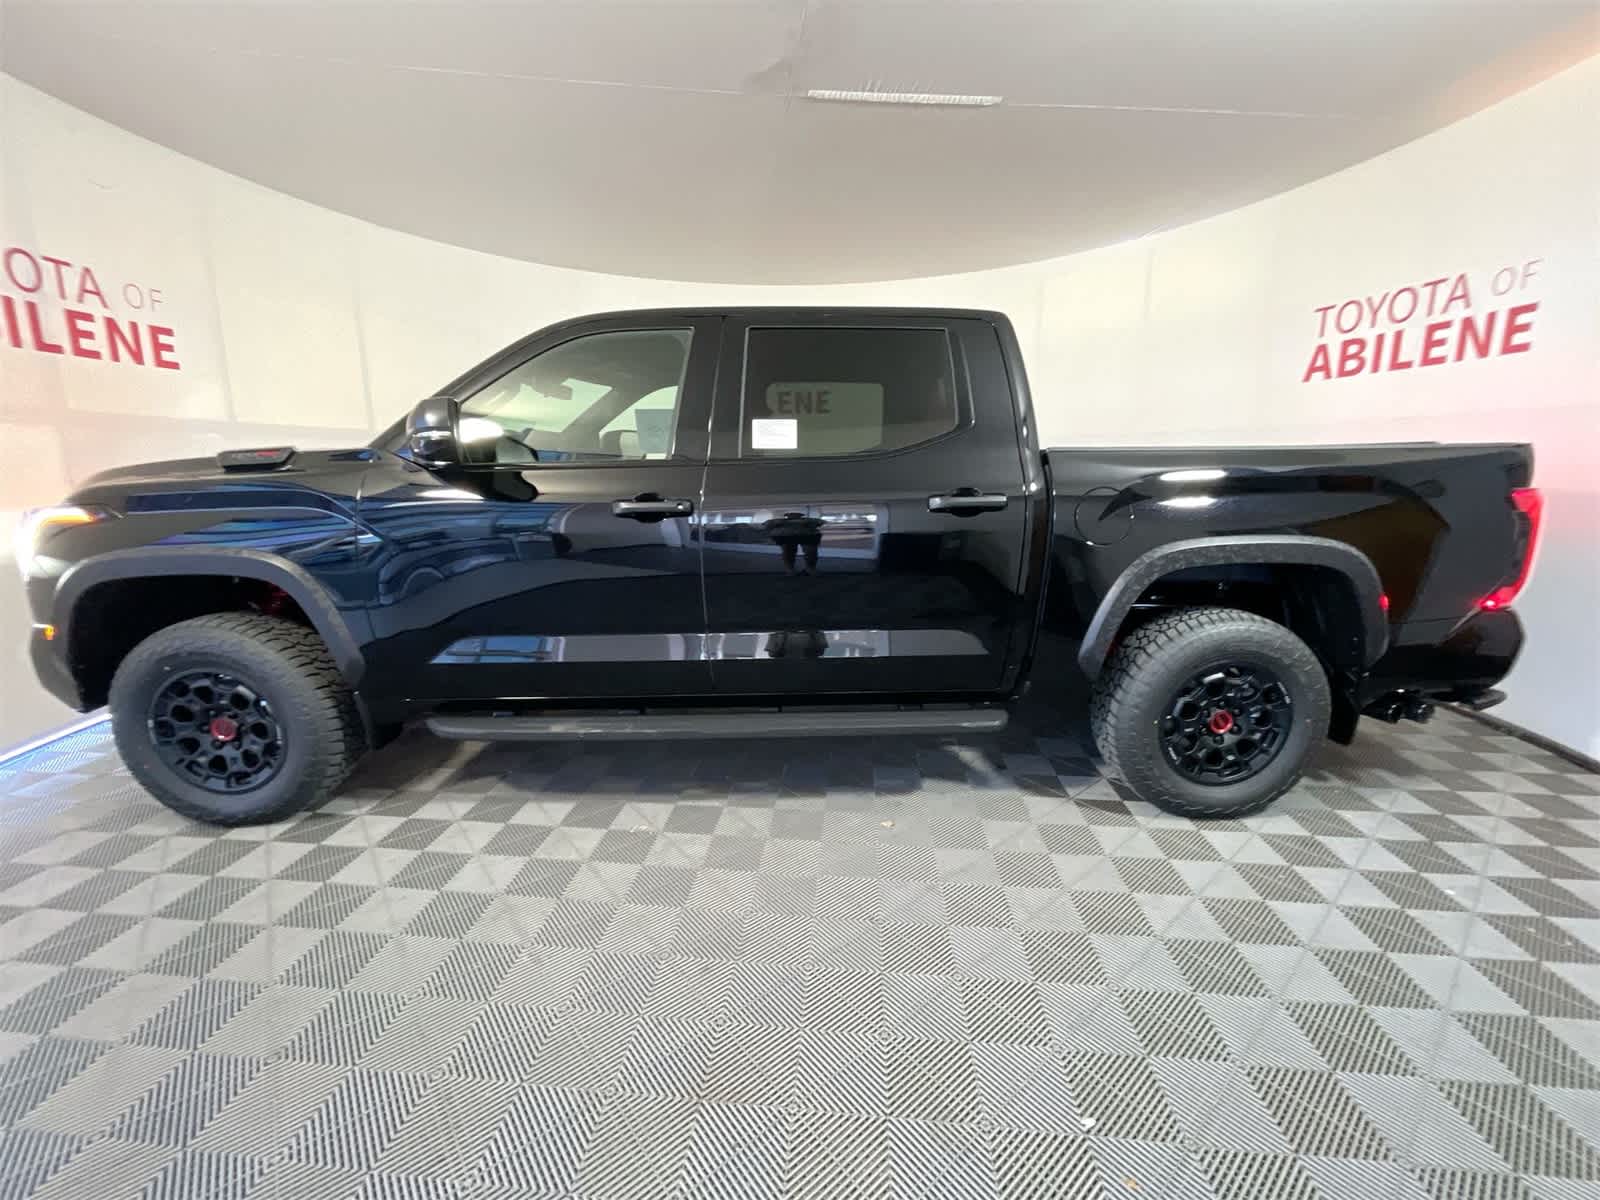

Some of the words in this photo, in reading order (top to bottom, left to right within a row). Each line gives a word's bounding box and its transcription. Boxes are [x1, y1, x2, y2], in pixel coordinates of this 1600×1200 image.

[3, 247, 109, 309] OTA
[122, 282, 163, 312] OF
[1313, 272, 1473, 338] TOYOTA
[1491, 258, 1544, 297] OF
[1301, 301, 1541, 383] ABILENE
[775, 389, 832, 415] ENE
